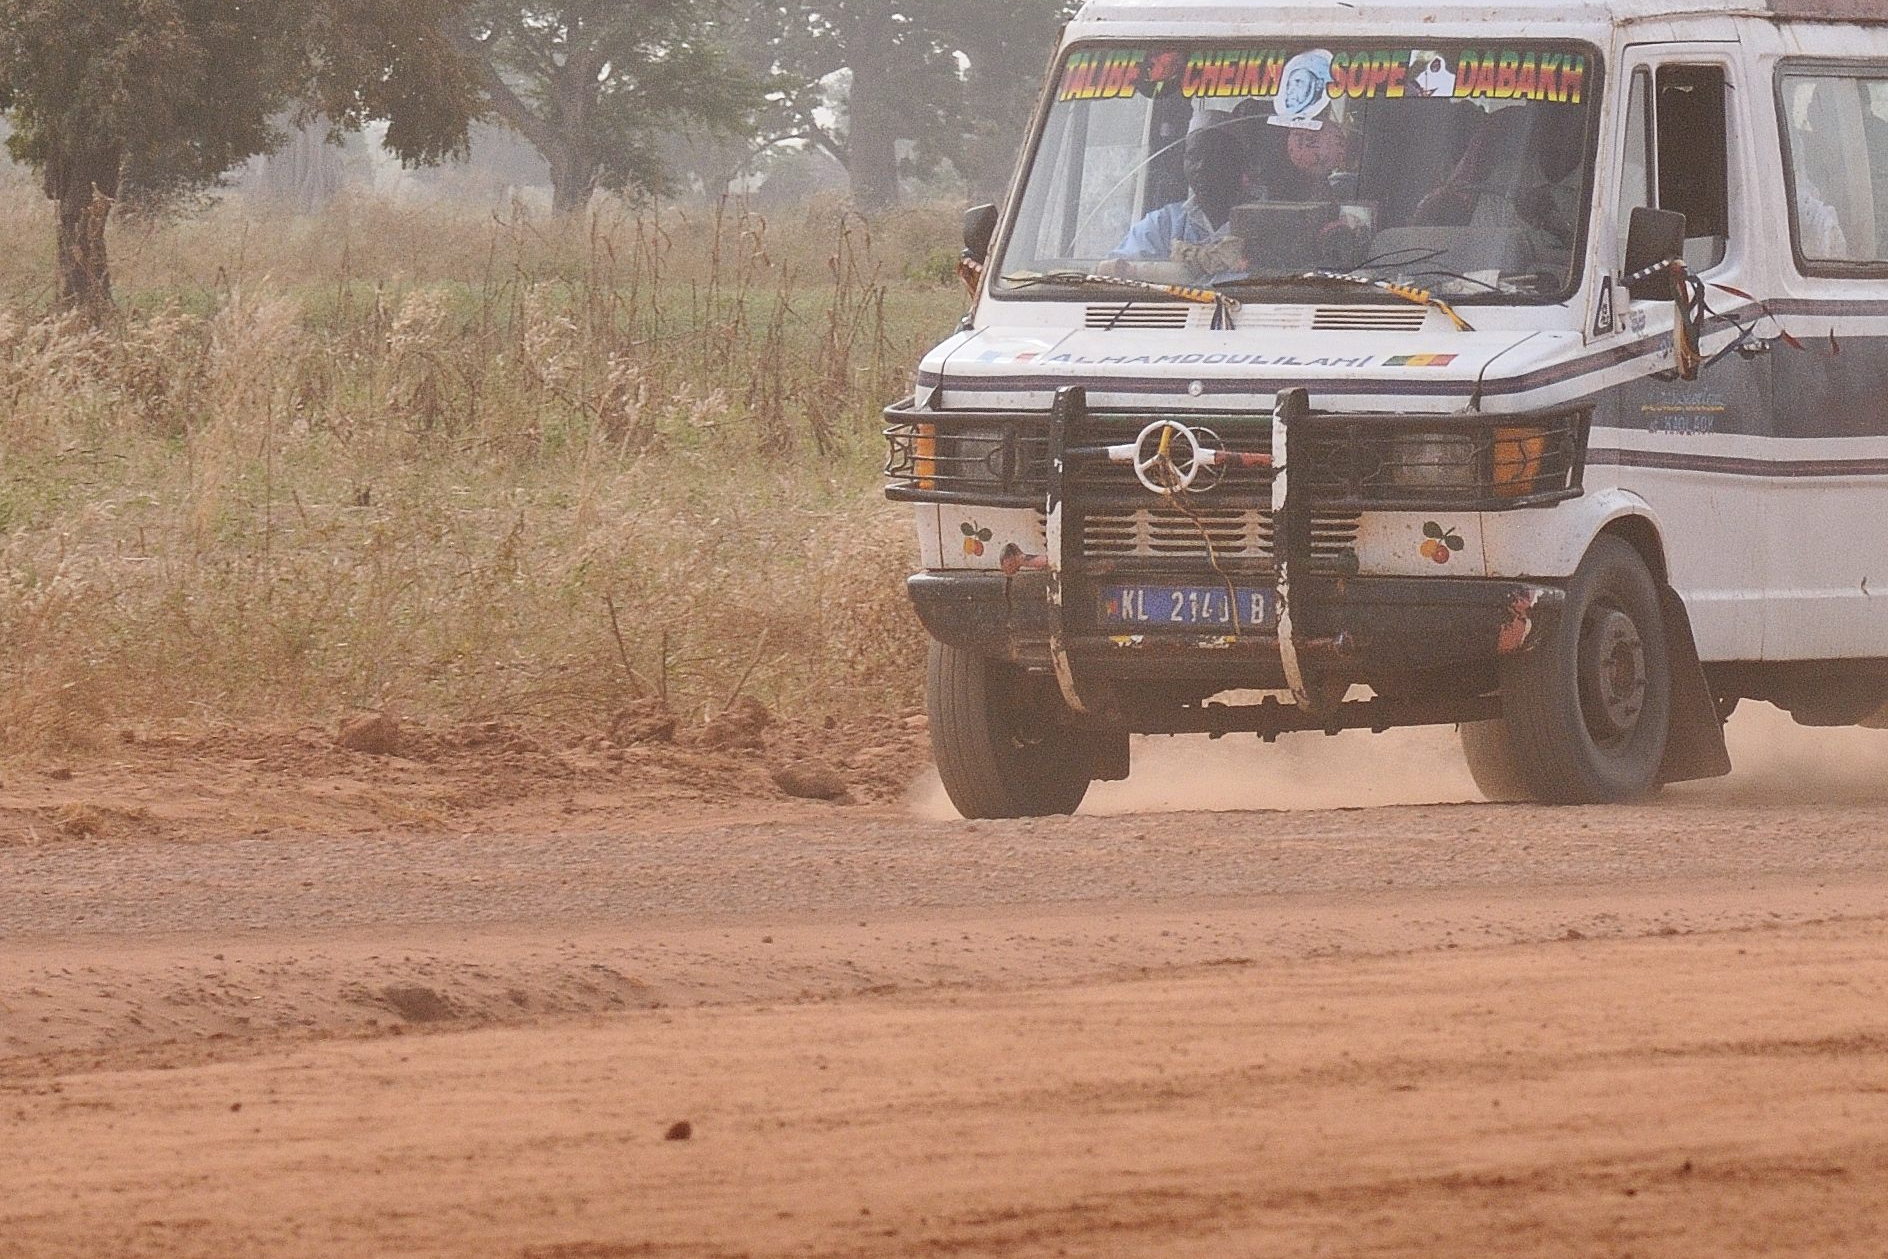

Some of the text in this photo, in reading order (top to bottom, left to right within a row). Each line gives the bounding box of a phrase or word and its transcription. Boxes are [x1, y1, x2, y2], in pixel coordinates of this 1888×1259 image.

[1059, 48, 1585, 103] TALIBE CHEIKH SOPE DABAKH
[1047, 353, 1375, 368] ALHAMDOULILAHI
[1121, 590, 1149, 621] KL
[1251, 593, 1264, 624] B
